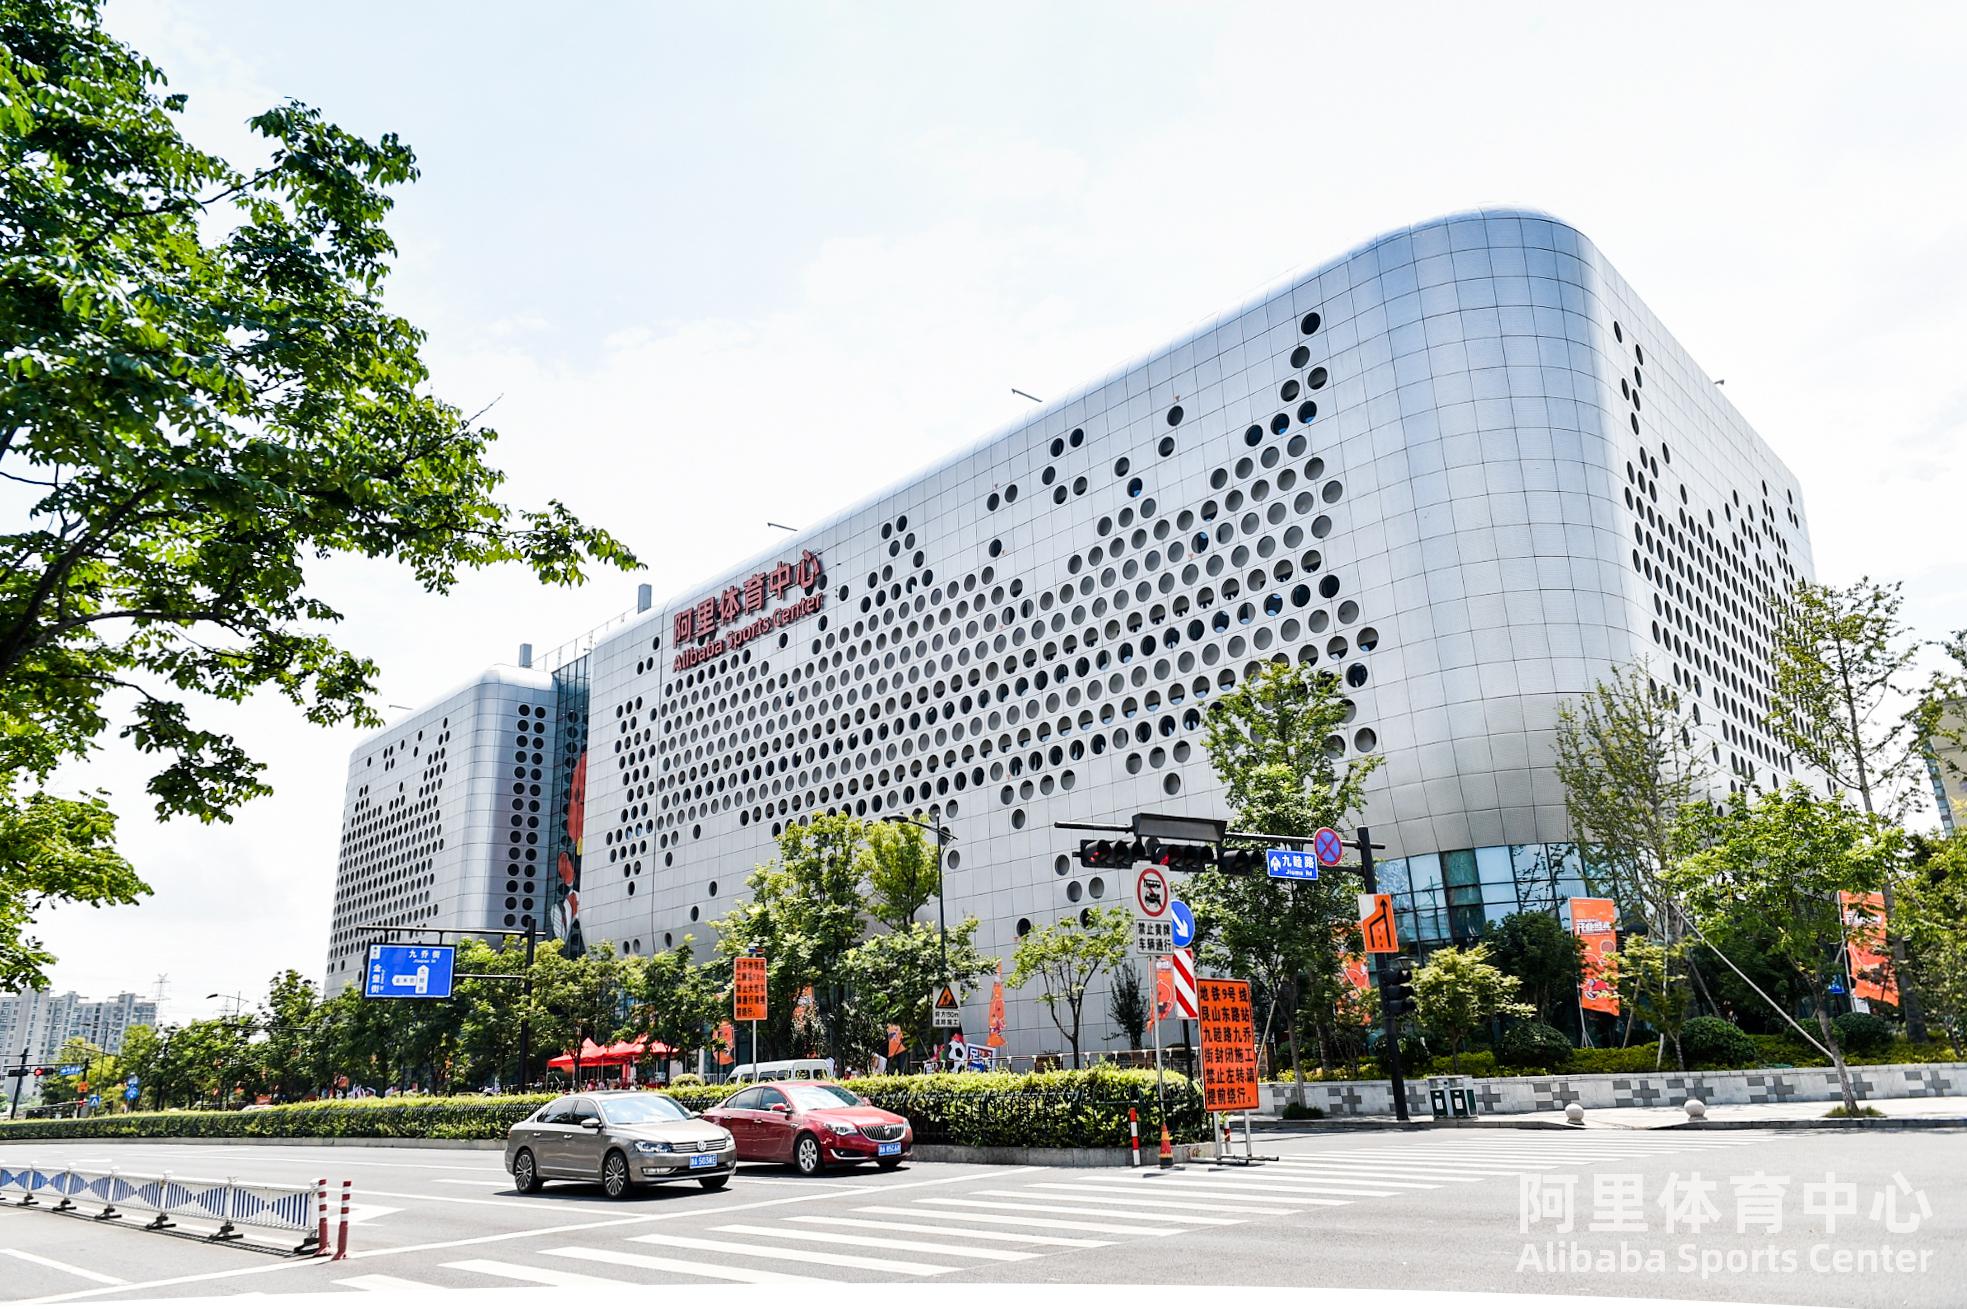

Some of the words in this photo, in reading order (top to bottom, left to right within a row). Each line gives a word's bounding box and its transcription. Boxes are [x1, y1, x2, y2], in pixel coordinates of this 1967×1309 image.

[673, 549, 820, 649] 阿里体育中心
[673, 639, 723, 672] Alibaba
[726, 616, 769, 649] Sports
[772, 592, 823, 627] Center
[1282, 854, 1315, 869] 九睦路
[1200, 985, 1249, 1003] 地铁9号线
[1201, 1005, 1250, 1022] 艮山东路站
[1203, 1026, 1252, 1043] 九睦路九乔
[1204, 1047, 1253, 1064] 街封闭施工
